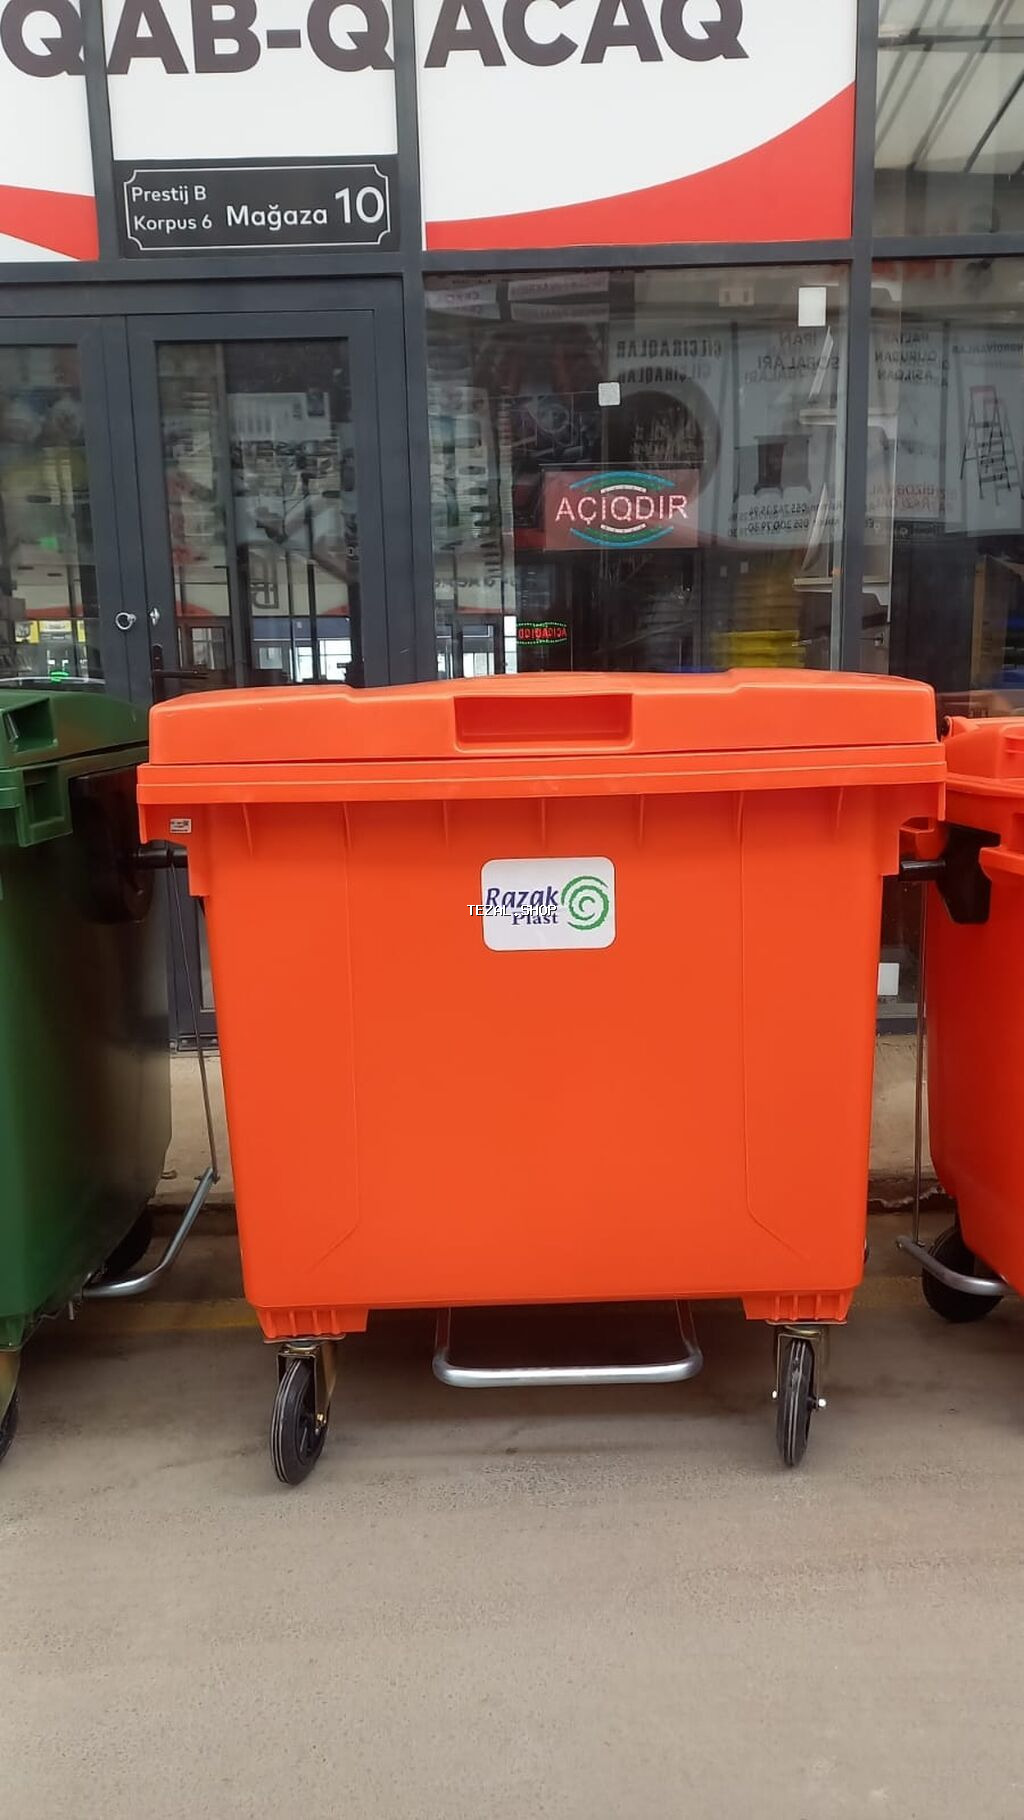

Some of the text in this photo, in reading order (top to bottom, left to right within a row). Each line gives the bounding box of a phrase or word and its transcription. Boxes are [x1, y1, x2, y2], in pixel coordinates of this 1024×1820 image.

[131, 185, 207, 205] Prestij B
[226, 186, 385, 231] Mağaza 10
[133, 215, 213, 234] Korpus 6
[555, 494, 689, 525] AÇIQDIR
[485, 886, 559, 909] Razak
[512, 910, 559, 926] Plast
